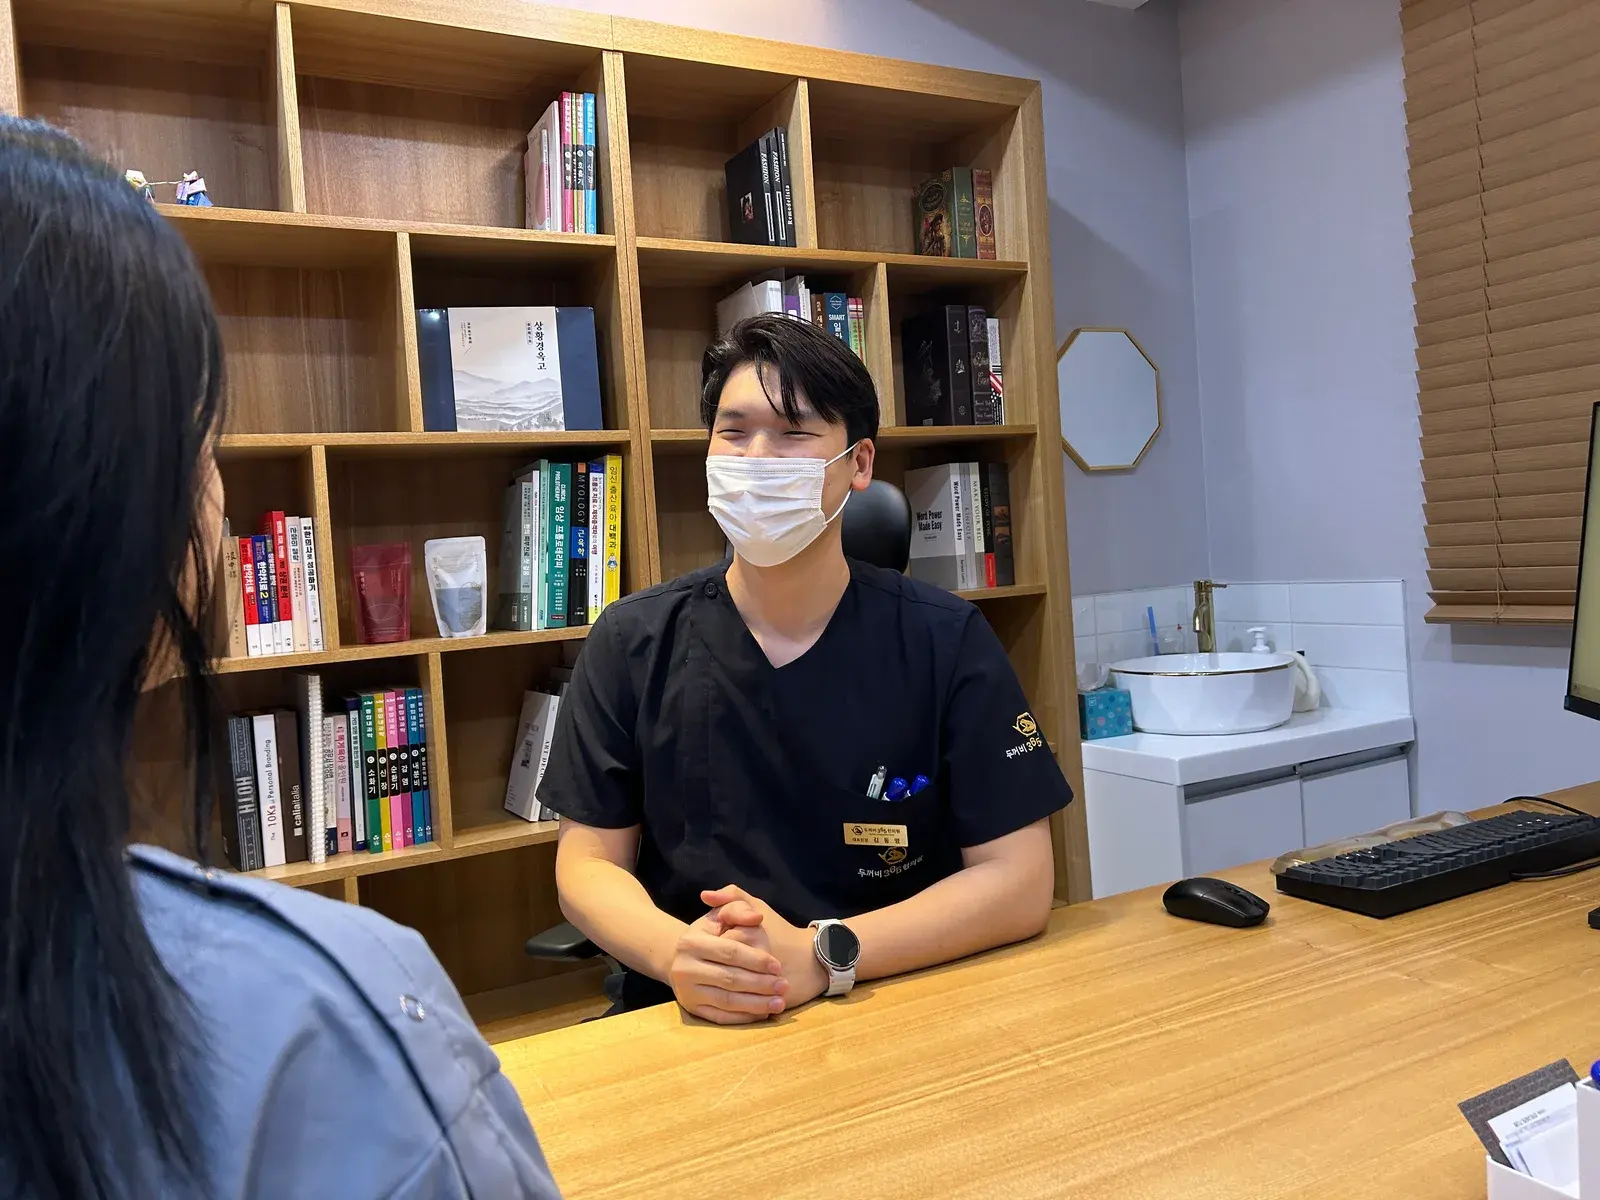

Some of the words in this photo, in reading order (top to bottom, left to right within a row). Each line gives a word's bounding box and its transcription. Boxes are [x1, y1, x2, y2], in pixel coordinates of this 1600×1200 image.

[761, 152, 769, 185] FASHION
[772, 151, 780, 183] FASHION
[785, 185, 793, 224] Remodelista
[534, 321, 546, 370] 상황경옥고
[610, 467, 617, 483] 임신
[592, 493, 598, 503] 치료
[610, 486, 617, 502] 출산
[555, 506, 564, 522] 임상
[609, 505, 617, 521] 육아
[916, 511, 928, 520] Word
[929, 510, 942, 519] Power
[918, 521, 930, 531] Made
[931, 520, 942, 531] Easy
[304, 531, 312, 559] 한의사로
[555, 525, 564, 568] 프롤로테라피
[243, 564, 254, 593] 한약치료
[257, 562, 268, 591] 한약치료
[307, 562, 316, 591] 성공하기
[264, 739, 272, 768] Branding
[1005, 737, 1042, 759] 두꺼비365
[265, 770, 274, 798] Personal
[368, 769, 376, 794] 소화기
[380, 769, 387, 790] 신장
[401, 765, 408, 786] 감염
[412, 762, 420, 786] 내분비
[236, 776, 254, 814] HOTH
[267, 804, 276, 827] 10Ks
